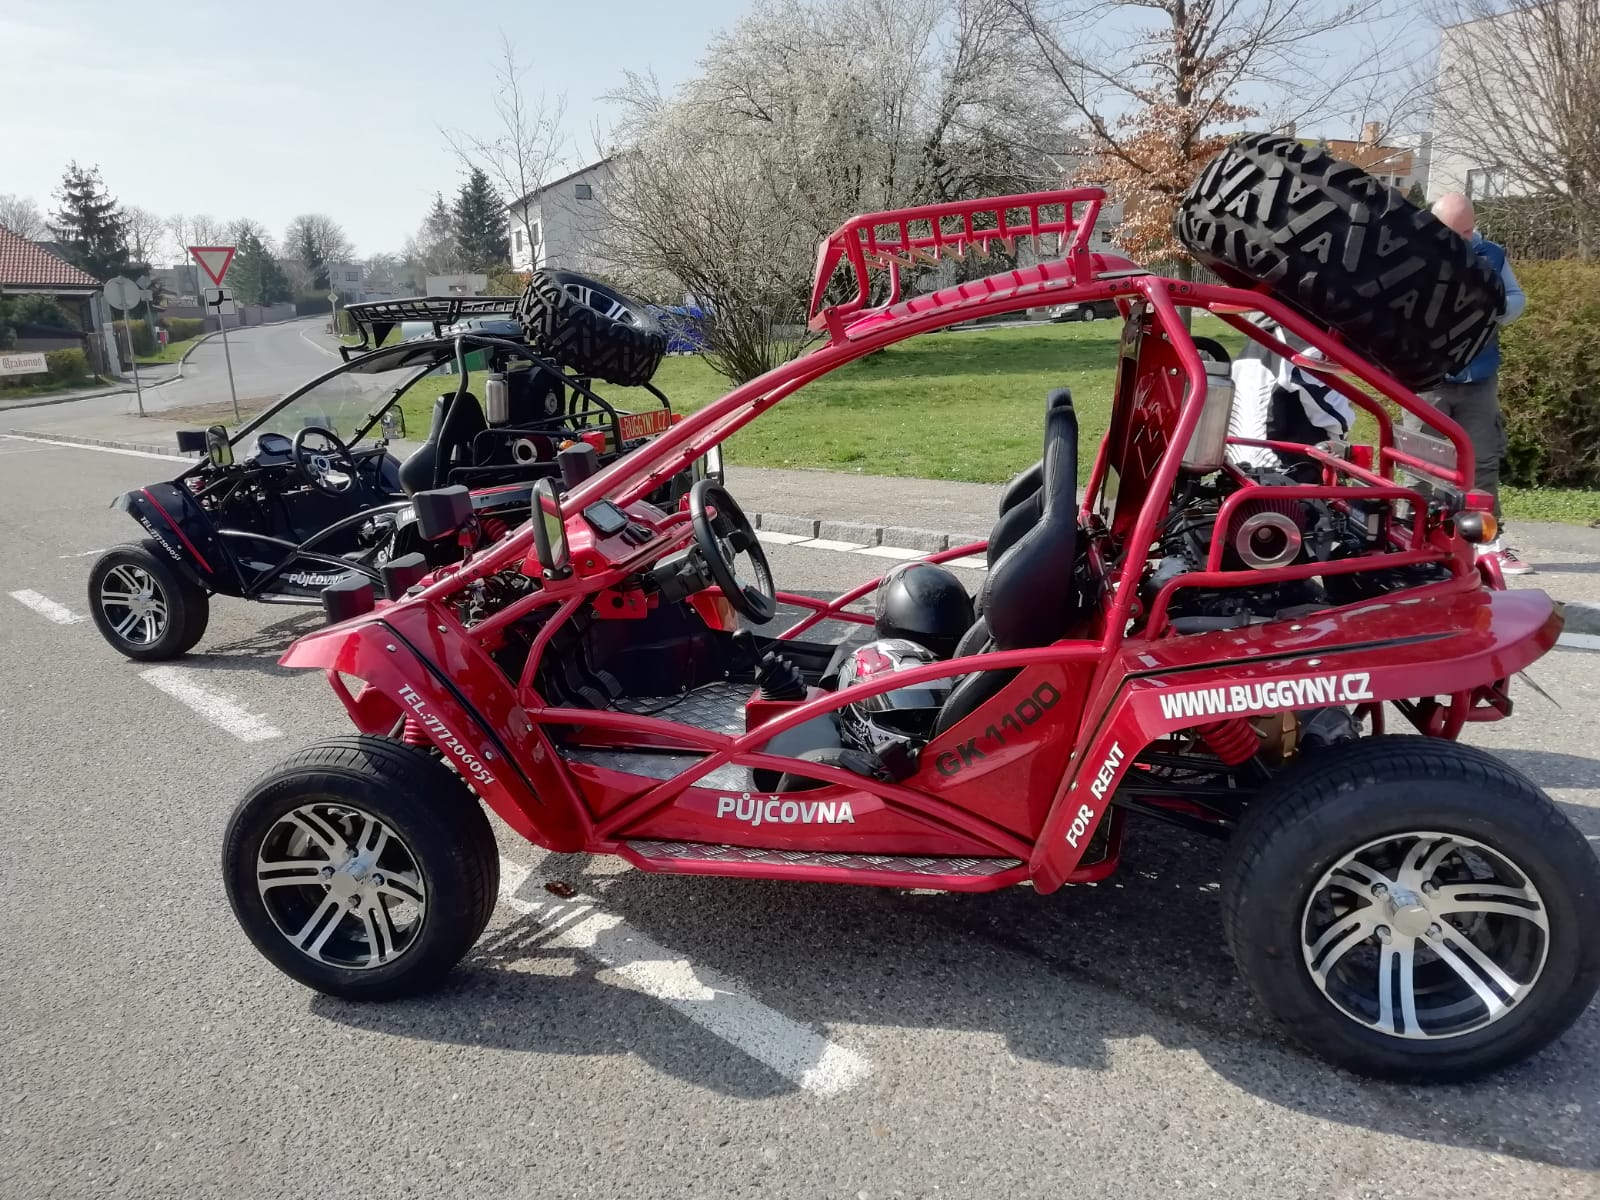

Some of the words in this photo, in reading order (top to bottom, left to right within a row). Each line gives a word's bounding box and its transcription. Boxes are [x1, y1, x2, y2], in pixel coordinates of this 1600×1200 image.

[935, 736, 988, 777] GK
[984, 681, 1062, 745] 1100
[1159, 672, 1374, 720] WWW.BUGGYNY.CZ
[715, 792, 856, 827] PŮJČOVNA
[1065, 804, 1095, 849] FOR
[1090, 740, 1125, 801] RENT
